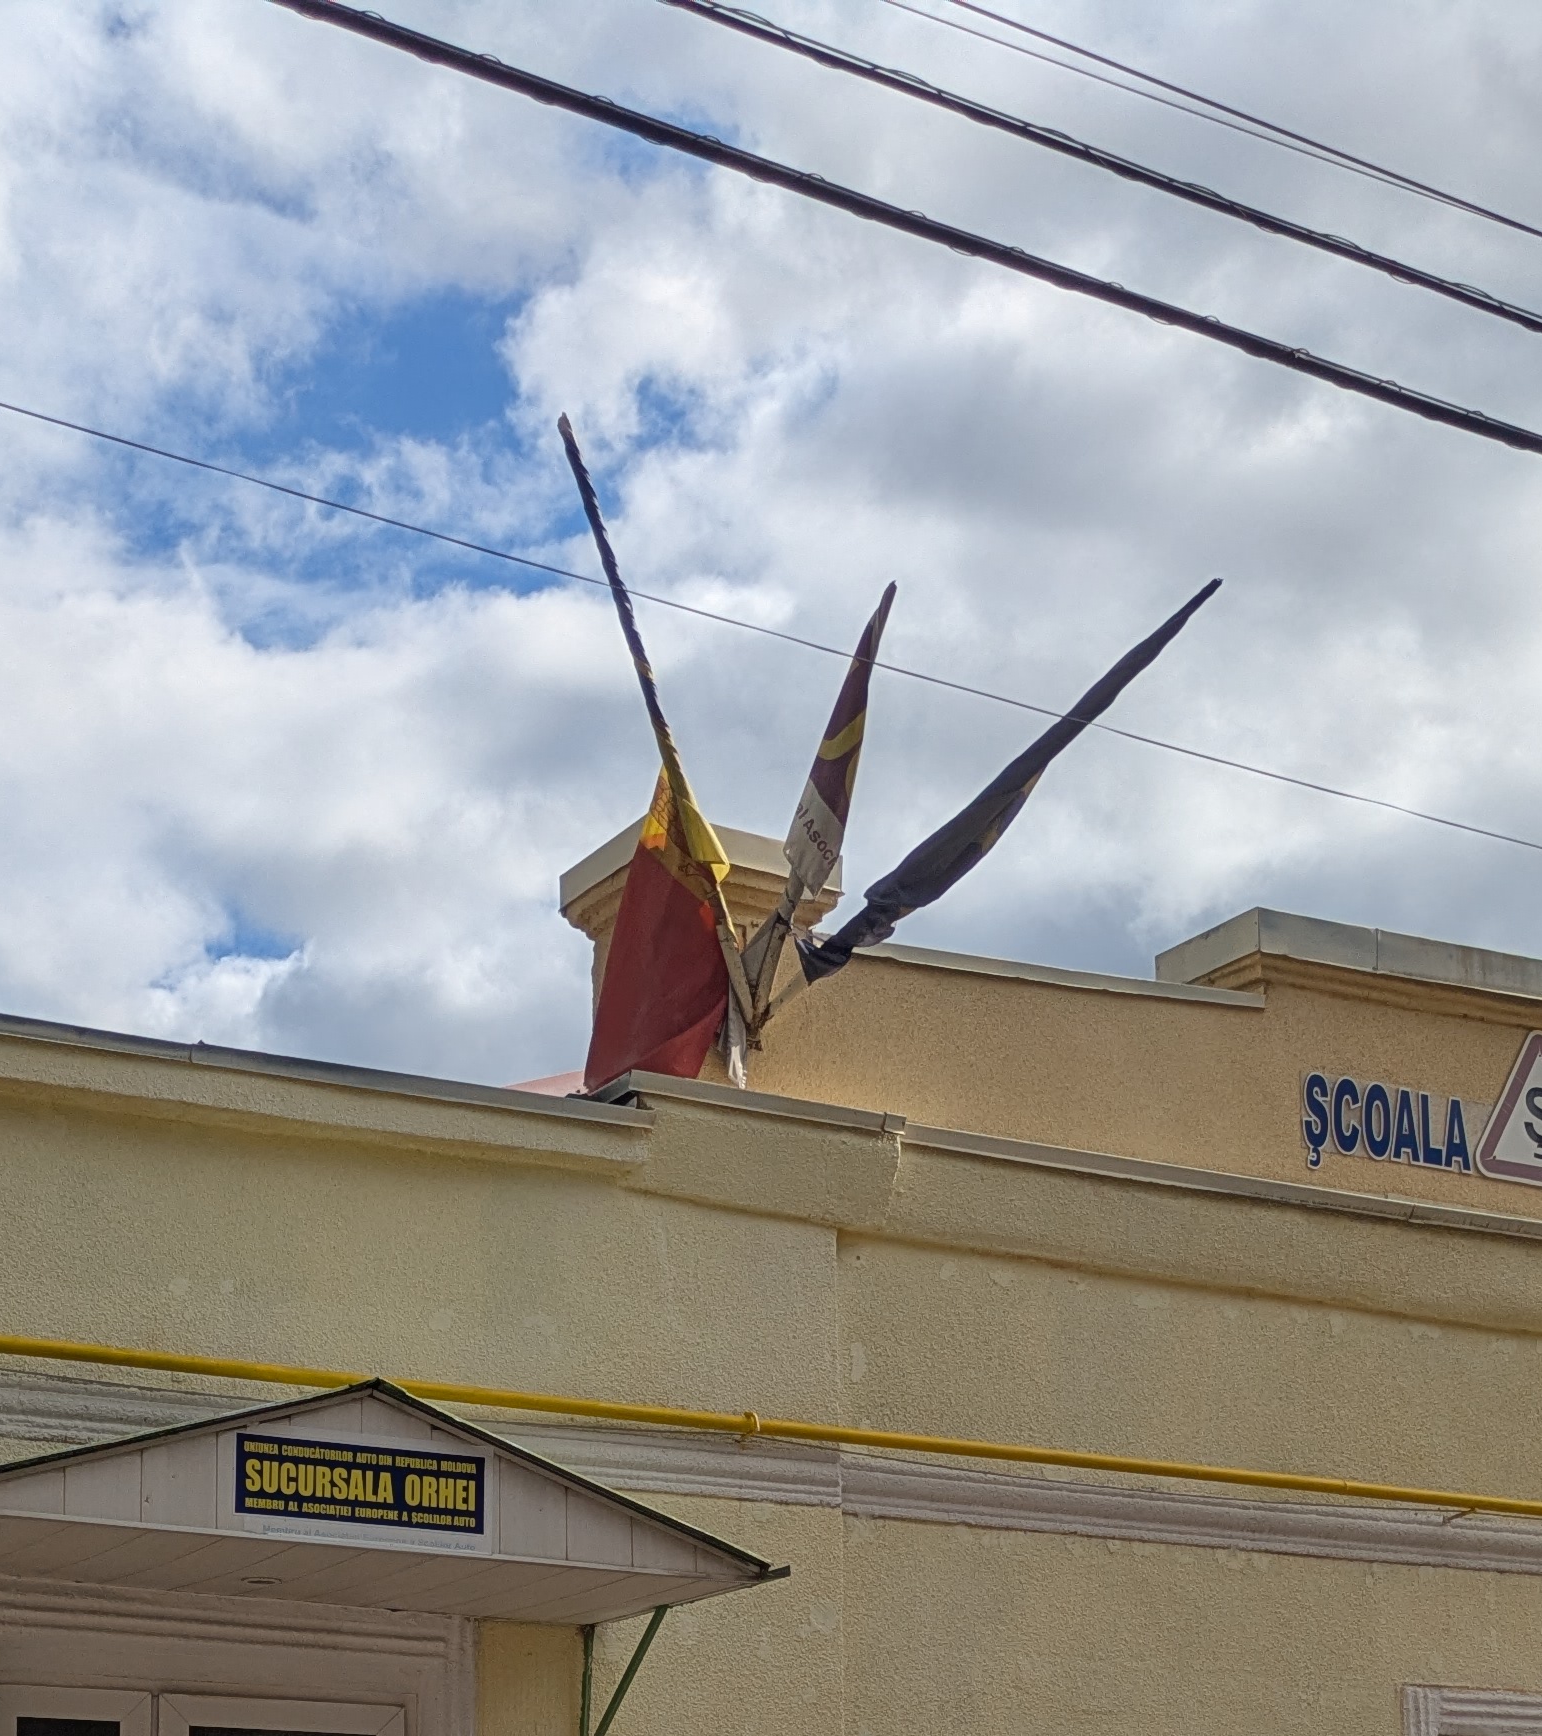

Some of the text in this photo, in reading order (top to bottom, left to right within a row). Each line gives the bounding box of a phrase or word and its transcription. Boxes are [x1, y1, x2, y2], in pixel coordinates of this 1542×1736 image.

[243, 1440, 279, 1455] UNIUNEA
[356, 1452, 377, 1465] AUTO
[379, 1454, 392, 1466] DIN
[395, 1456, 438, 1470] REPUBLICA
[440, 1461, 477, 1474] MOLDOVA
[245, 1458, 476, 1512] SUCURSALA ORHEI
[245, 1497, 285, 1511] MEMBRU
[288, 1501, 299, 1512] AL
[354, 1507, 399, 1521] EUROPENE
[402, 1511, 408, 1522] A
[453, 1515, 476, 1528] AUTO
